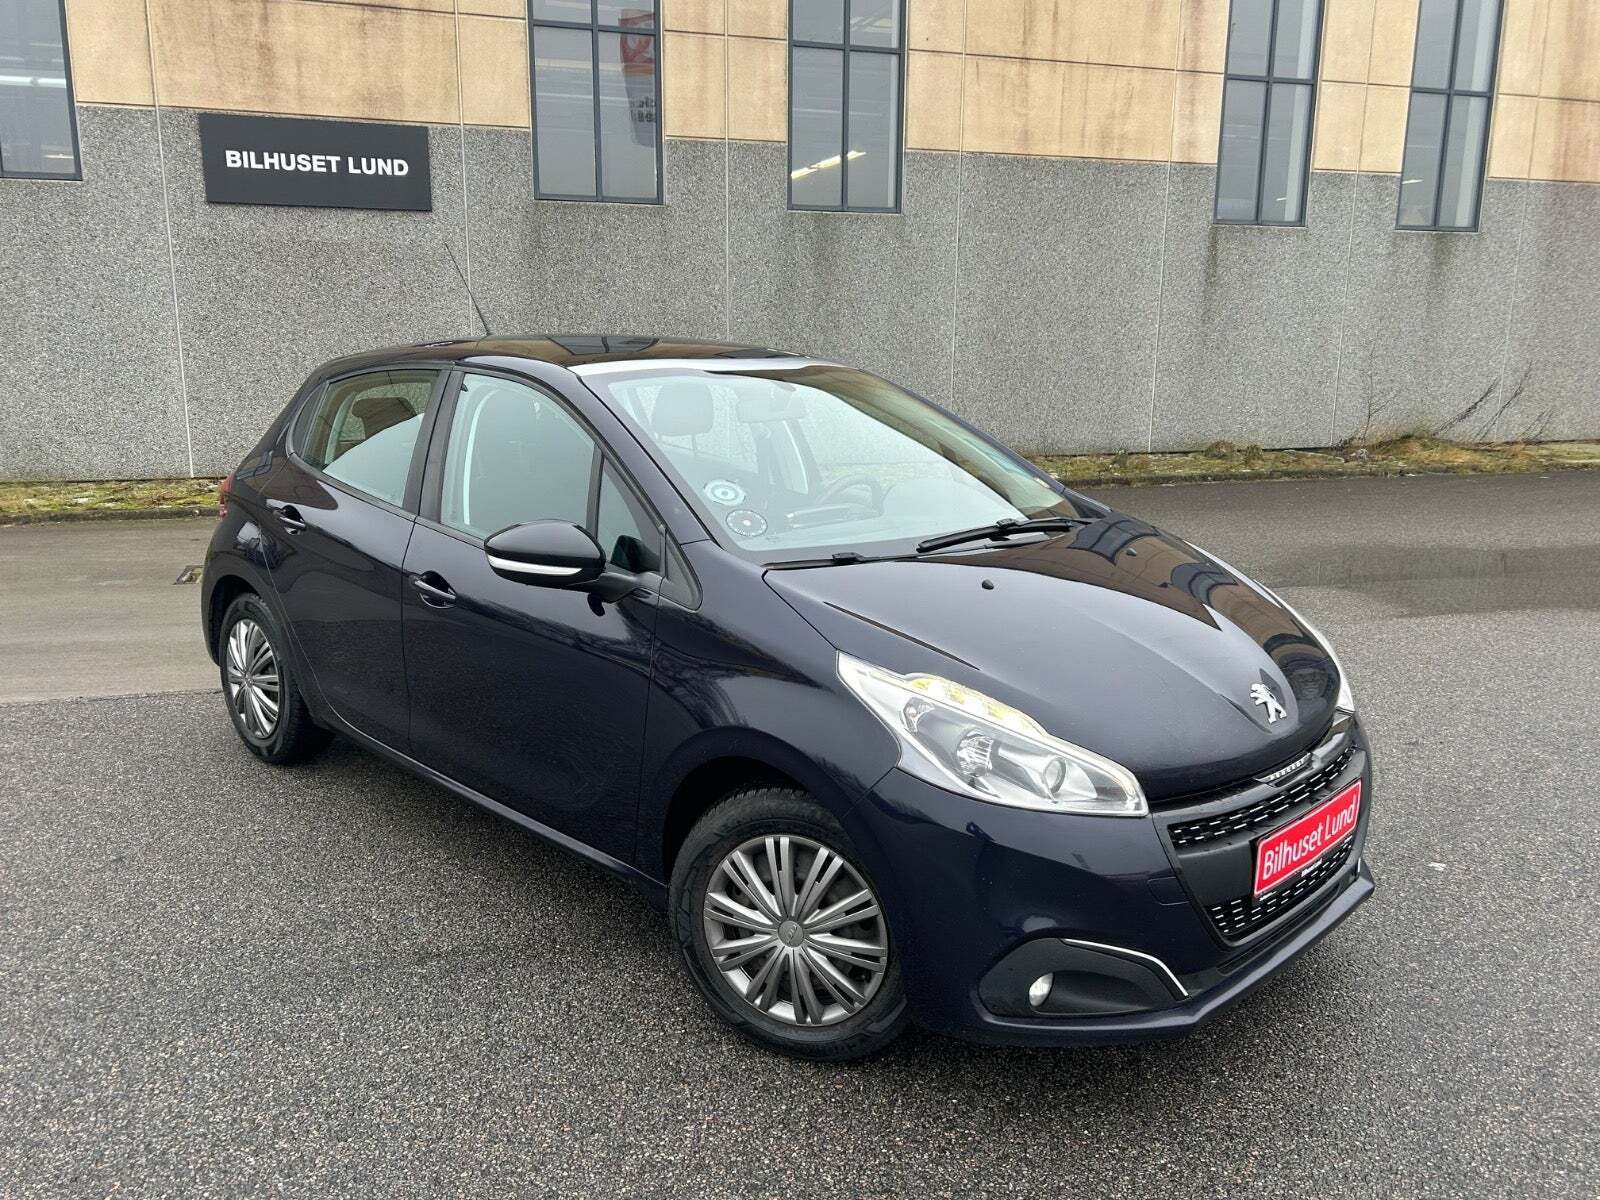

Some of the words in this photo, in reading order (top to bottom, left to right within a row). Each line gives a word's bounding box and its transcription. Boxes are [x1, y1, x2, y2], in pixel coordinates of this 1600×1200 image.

[225, 150, 340, 173] BILHUSET
[348, 156, 409, 176] LUND
[1262, 822, 1323, 880] Bilhuset
[1324, 795, 1356, 841] Lund
